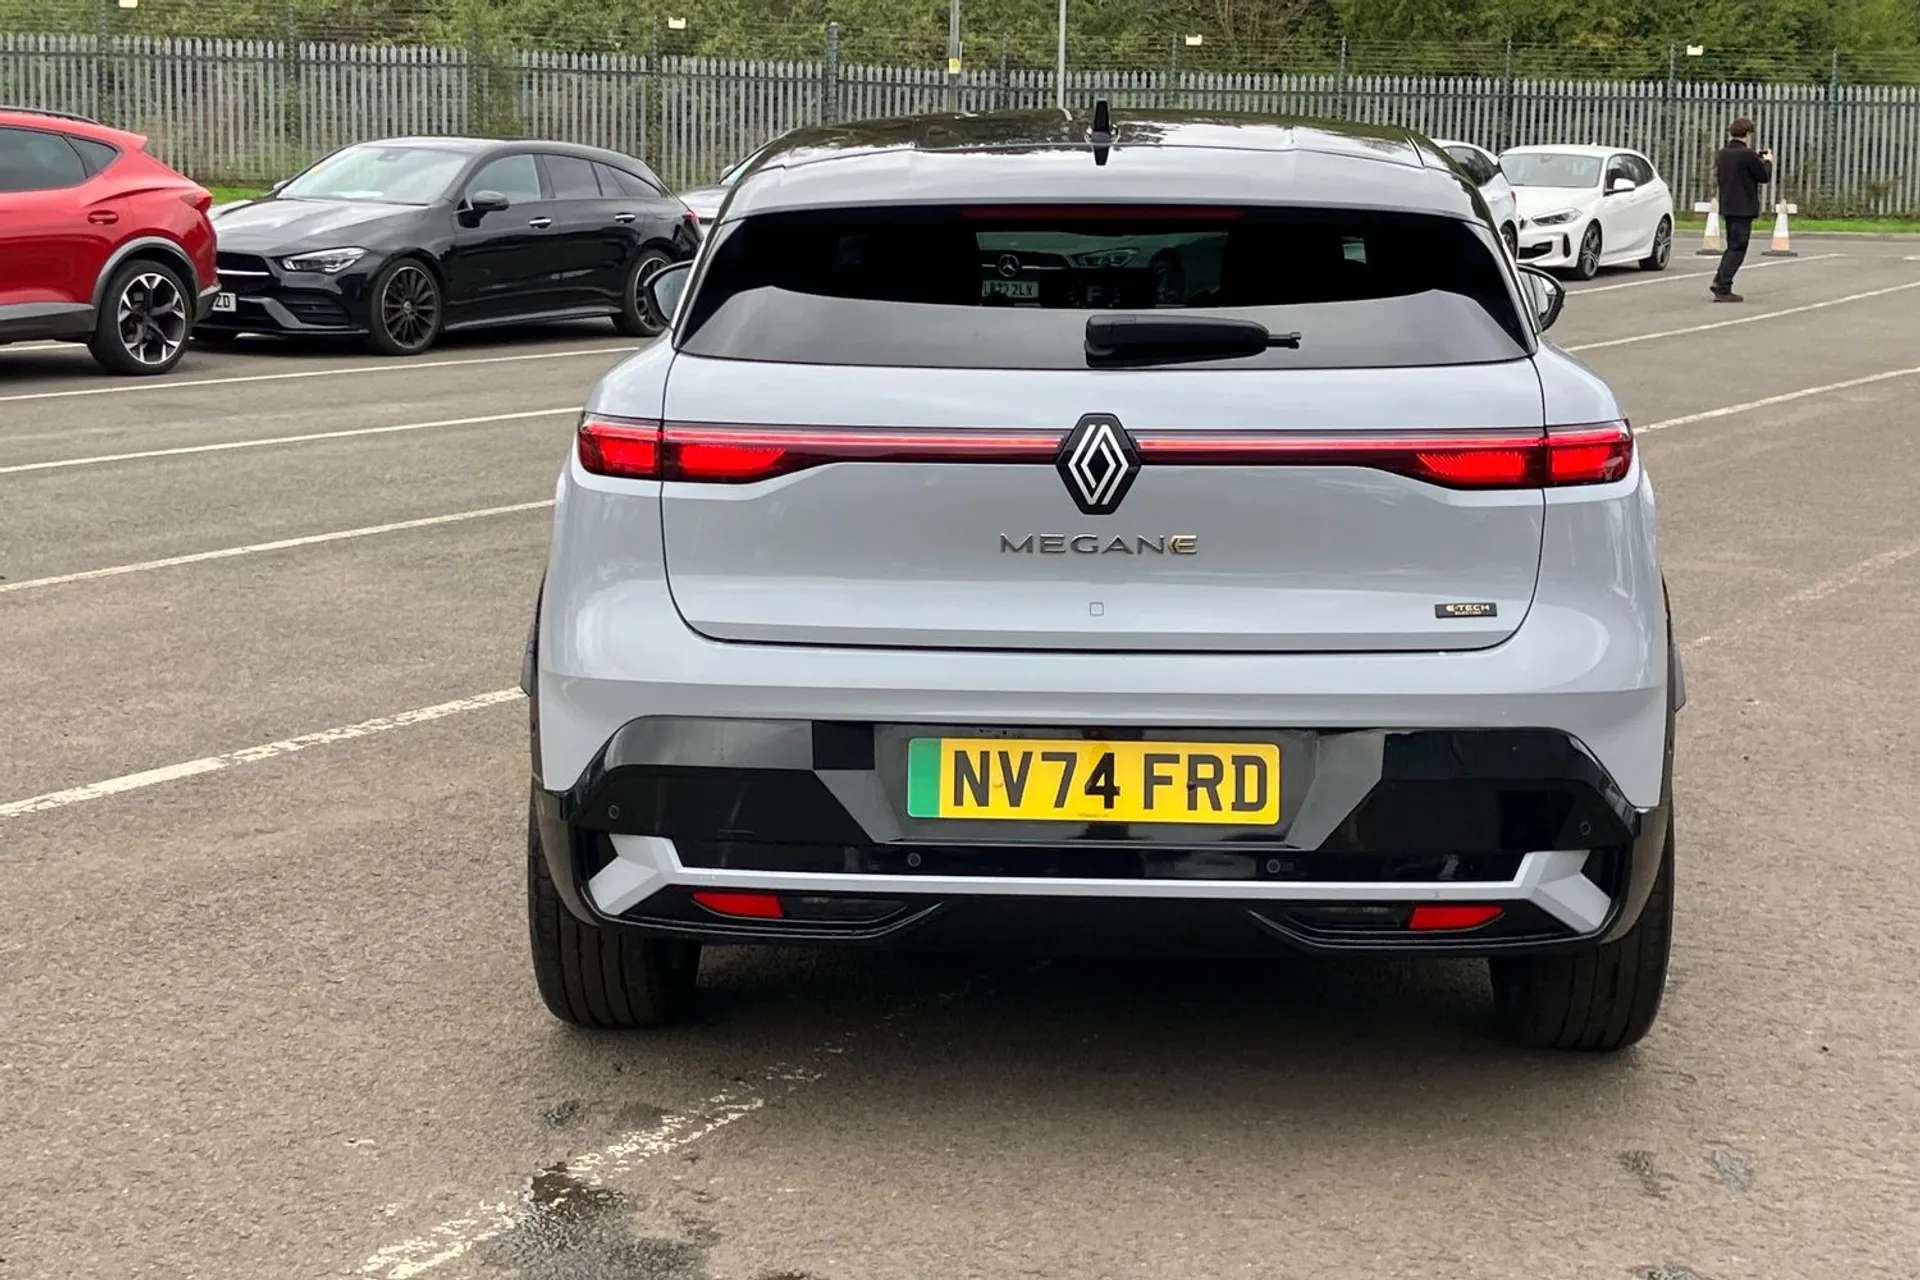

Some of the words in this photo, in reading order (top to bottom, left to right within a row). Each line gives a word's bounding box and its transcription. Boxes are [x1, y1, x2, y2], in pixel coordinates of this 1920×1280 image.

[1000, 533, 1198, 555] MEGANE
[953, 750, 1121, 809] NV74
[1143, 753, 1269, 812] FRD
